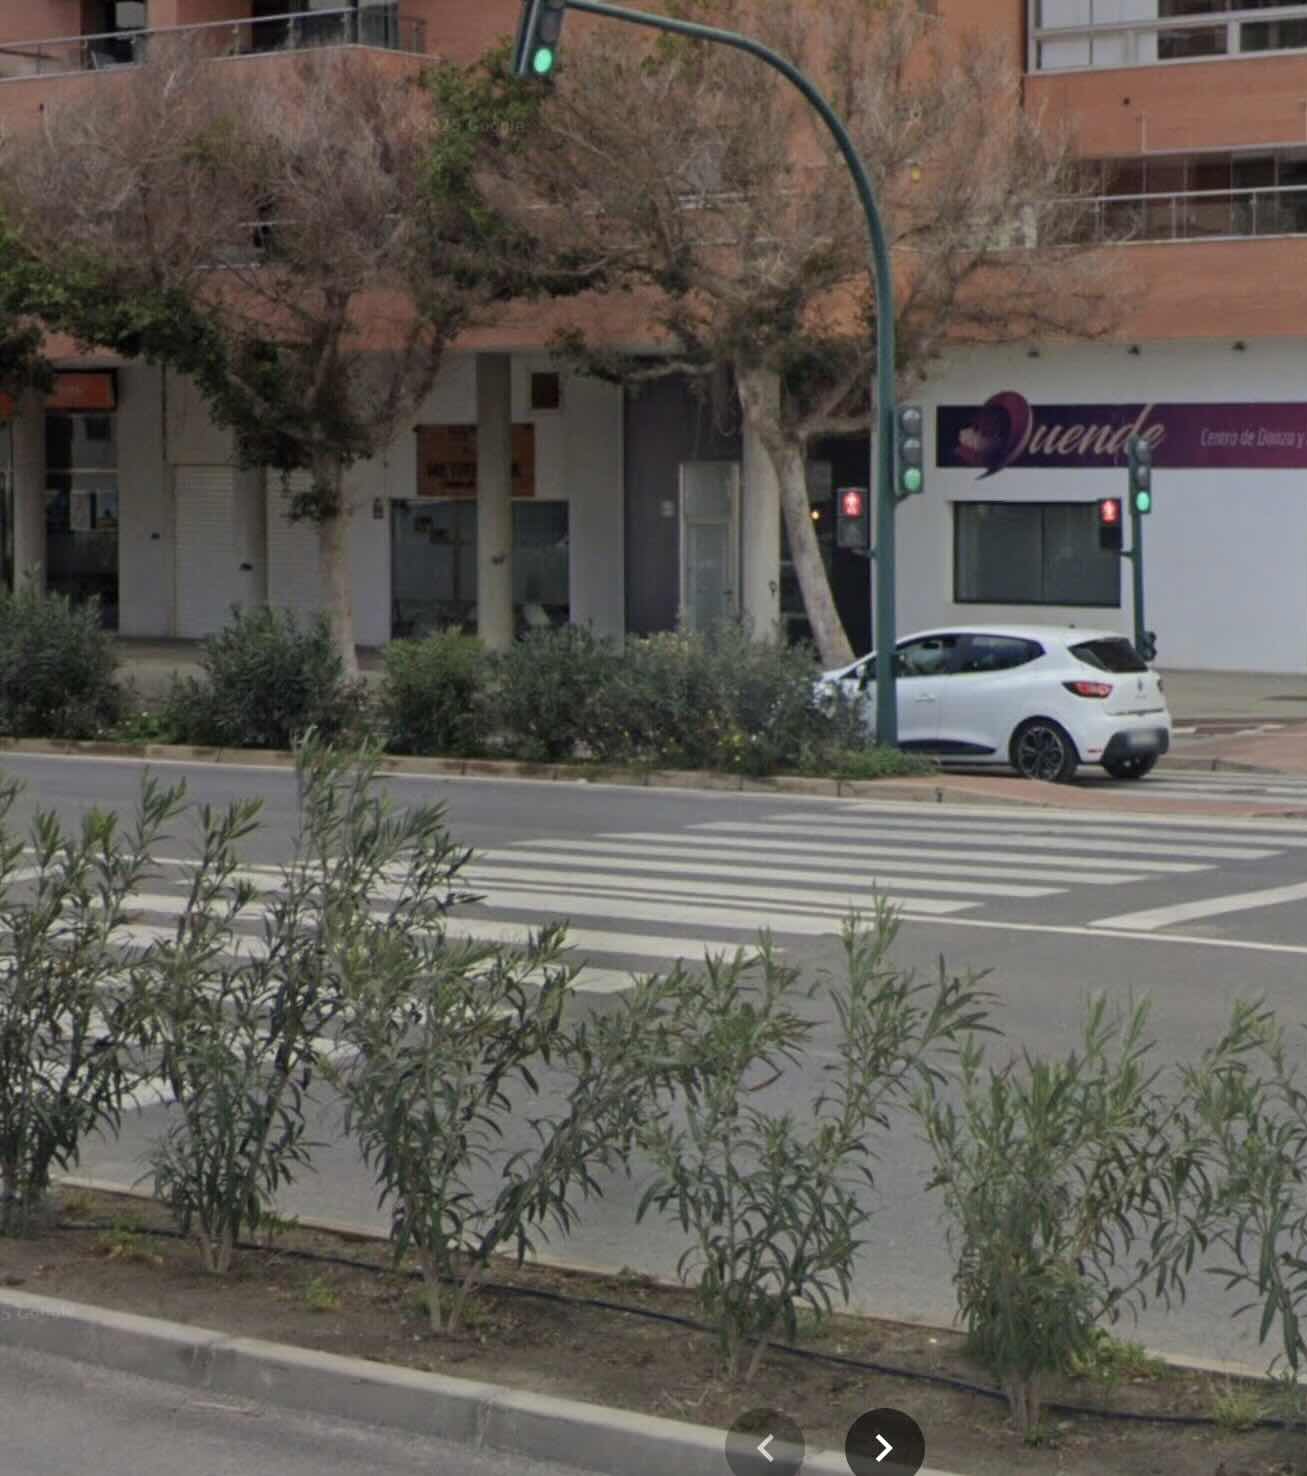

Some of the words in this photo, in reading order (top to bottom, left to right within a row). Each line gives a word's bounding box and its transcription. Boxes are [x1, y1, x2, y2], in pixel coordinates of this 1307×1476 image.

[1200, 427, 1238, 447] Centro
[1239, 427, 1255, 447] de
[1256, 427, 1296, 447] Danza
